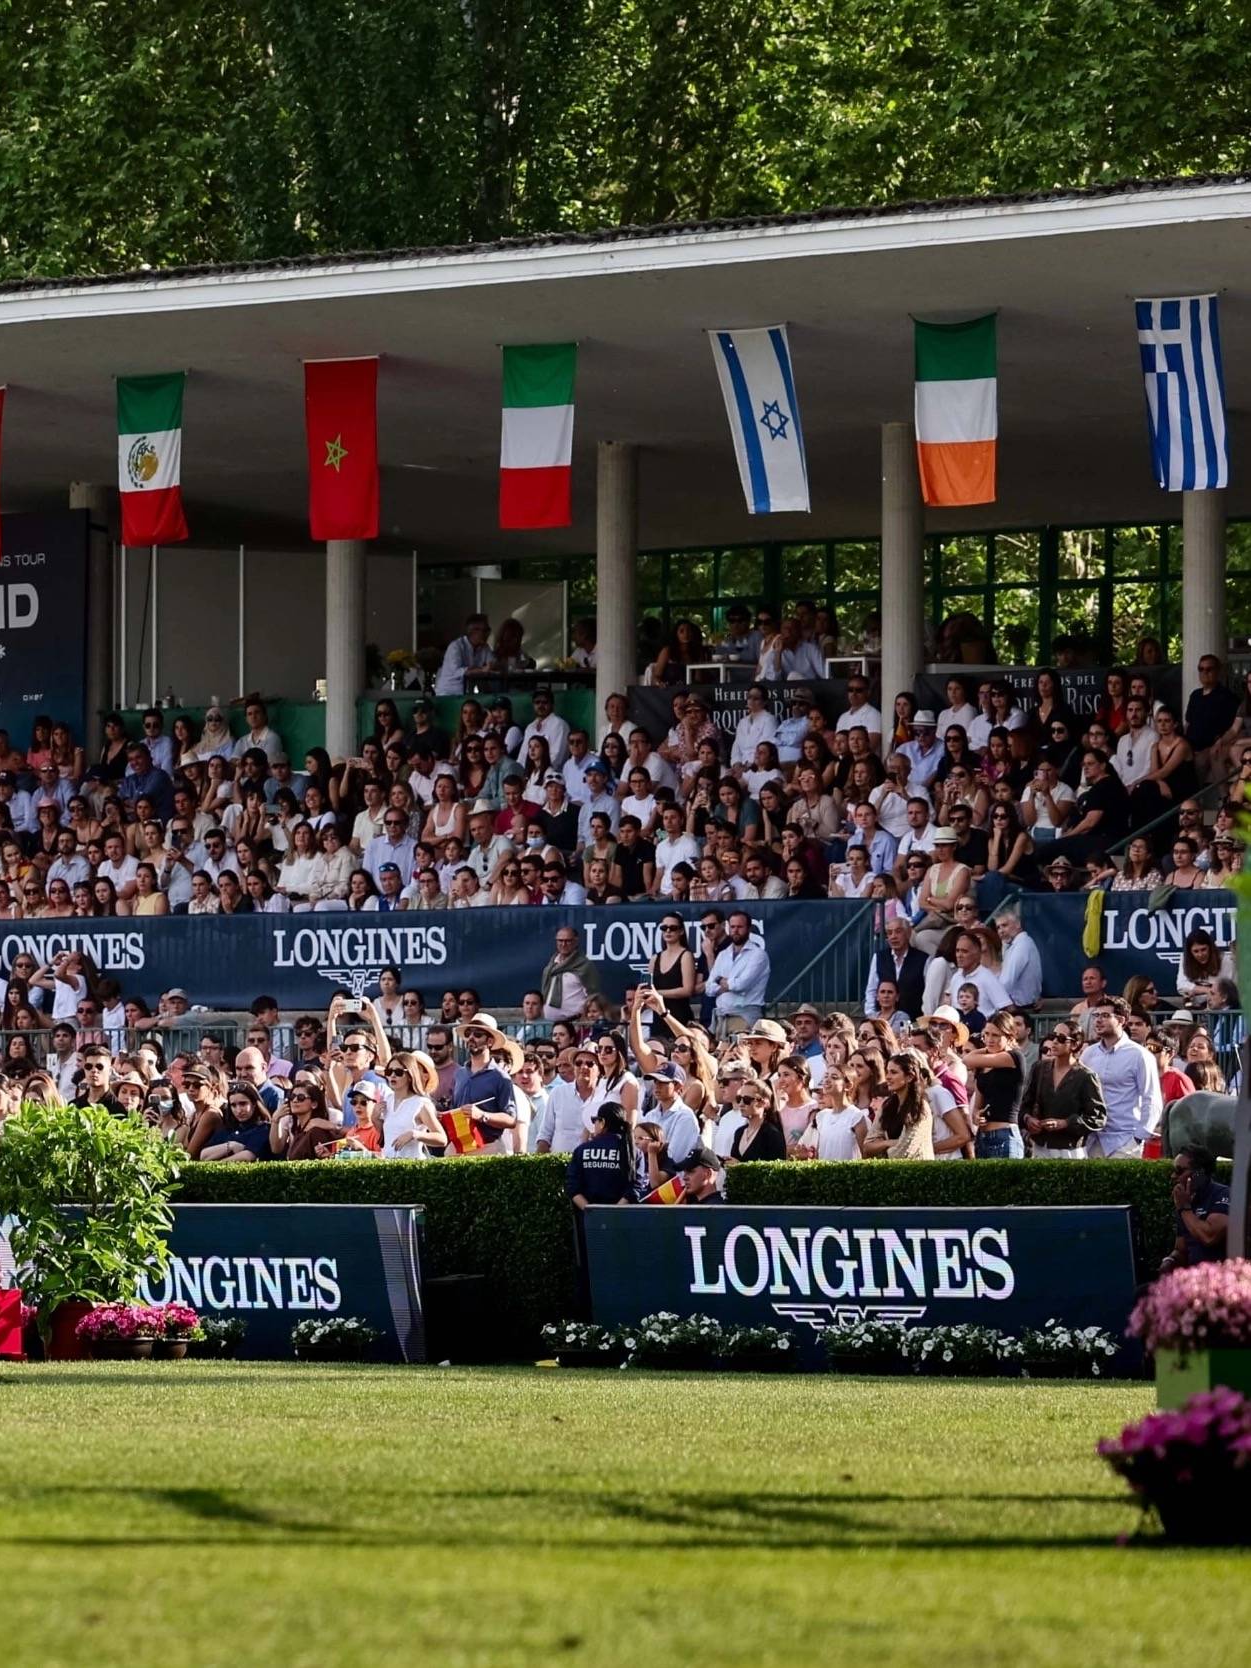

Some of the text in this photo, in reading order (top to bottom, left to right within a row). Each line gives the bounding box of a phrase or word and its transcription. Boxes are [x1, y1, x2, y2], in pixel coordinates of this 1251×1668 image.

[14, 552, 46, 566] TOUR
[273, 926, 447, 968] LONGINES
[1103, 906, 1238, 950] LONGI
[582, 1161, 621, 1169] SEGURIDA
[136, 1255, 343, 1312] ONGINES
[684, 1225, 1016, 1300] LONGINES
